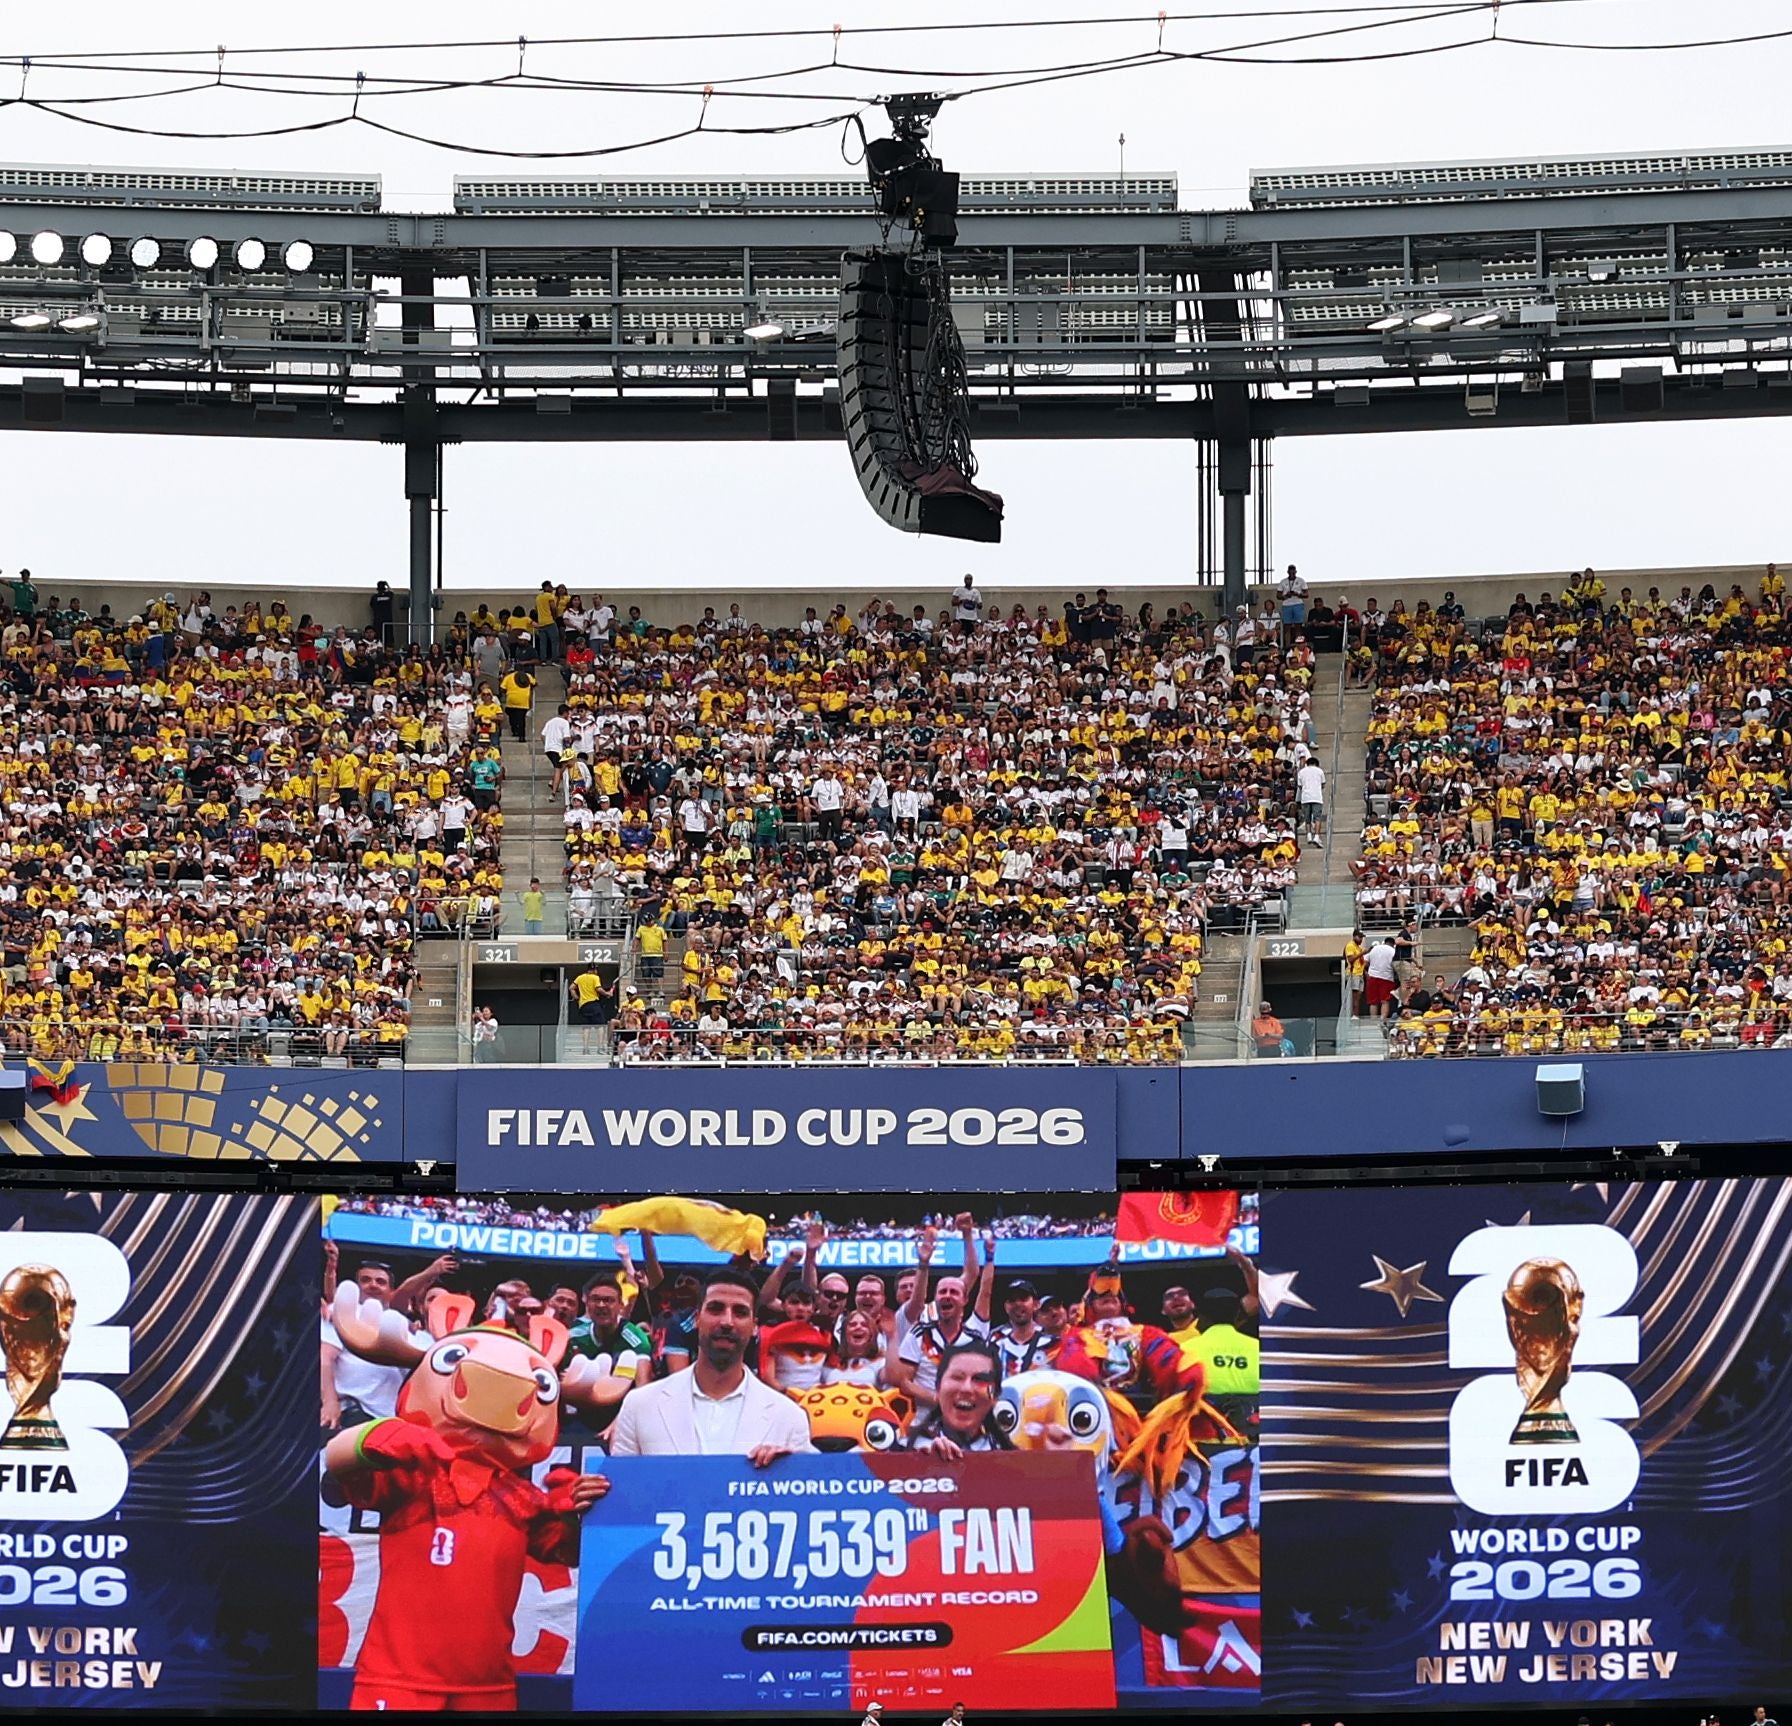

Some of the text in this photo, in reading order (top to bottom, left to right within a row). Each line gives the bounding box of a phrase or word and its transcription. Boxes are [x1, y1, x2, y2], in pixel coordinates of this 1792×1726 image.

[485, 949, 512, 962] 321
[584, 949, 612, 962] 322
[1272, 943, 1300, 957] 322
[487, 1108, 1085, 1147] FIFA WORLD CUP 2026
[411, 1221, 599, 1258] POWERADE
[1504, 1457, 1590, 1487] FIFA
[728, 1478, 952, 1497] FIFA WORLD CUP 2026
[62, 1534, 128, 1558] CUP
[939, 1507, 1036, 1575] FAN
[1450, 1526, 1641, 1554] WORLD CUP
[1450, 1558, 1642, 1600] 2026
[650, 1590, 1039, 1611] ALL-TIME TOURNAMENT RECORD
[28, 1626, 139, 1655] YORK
[757, 1629, 937, 1646] FIFA.COM/TICKETS
[1440, 1618, 1653, 1650] NEW YORK
[2, 1659, 161, 1688] JERSEY
[1416, 1651, 1677, 1684] NEW JERSEY
